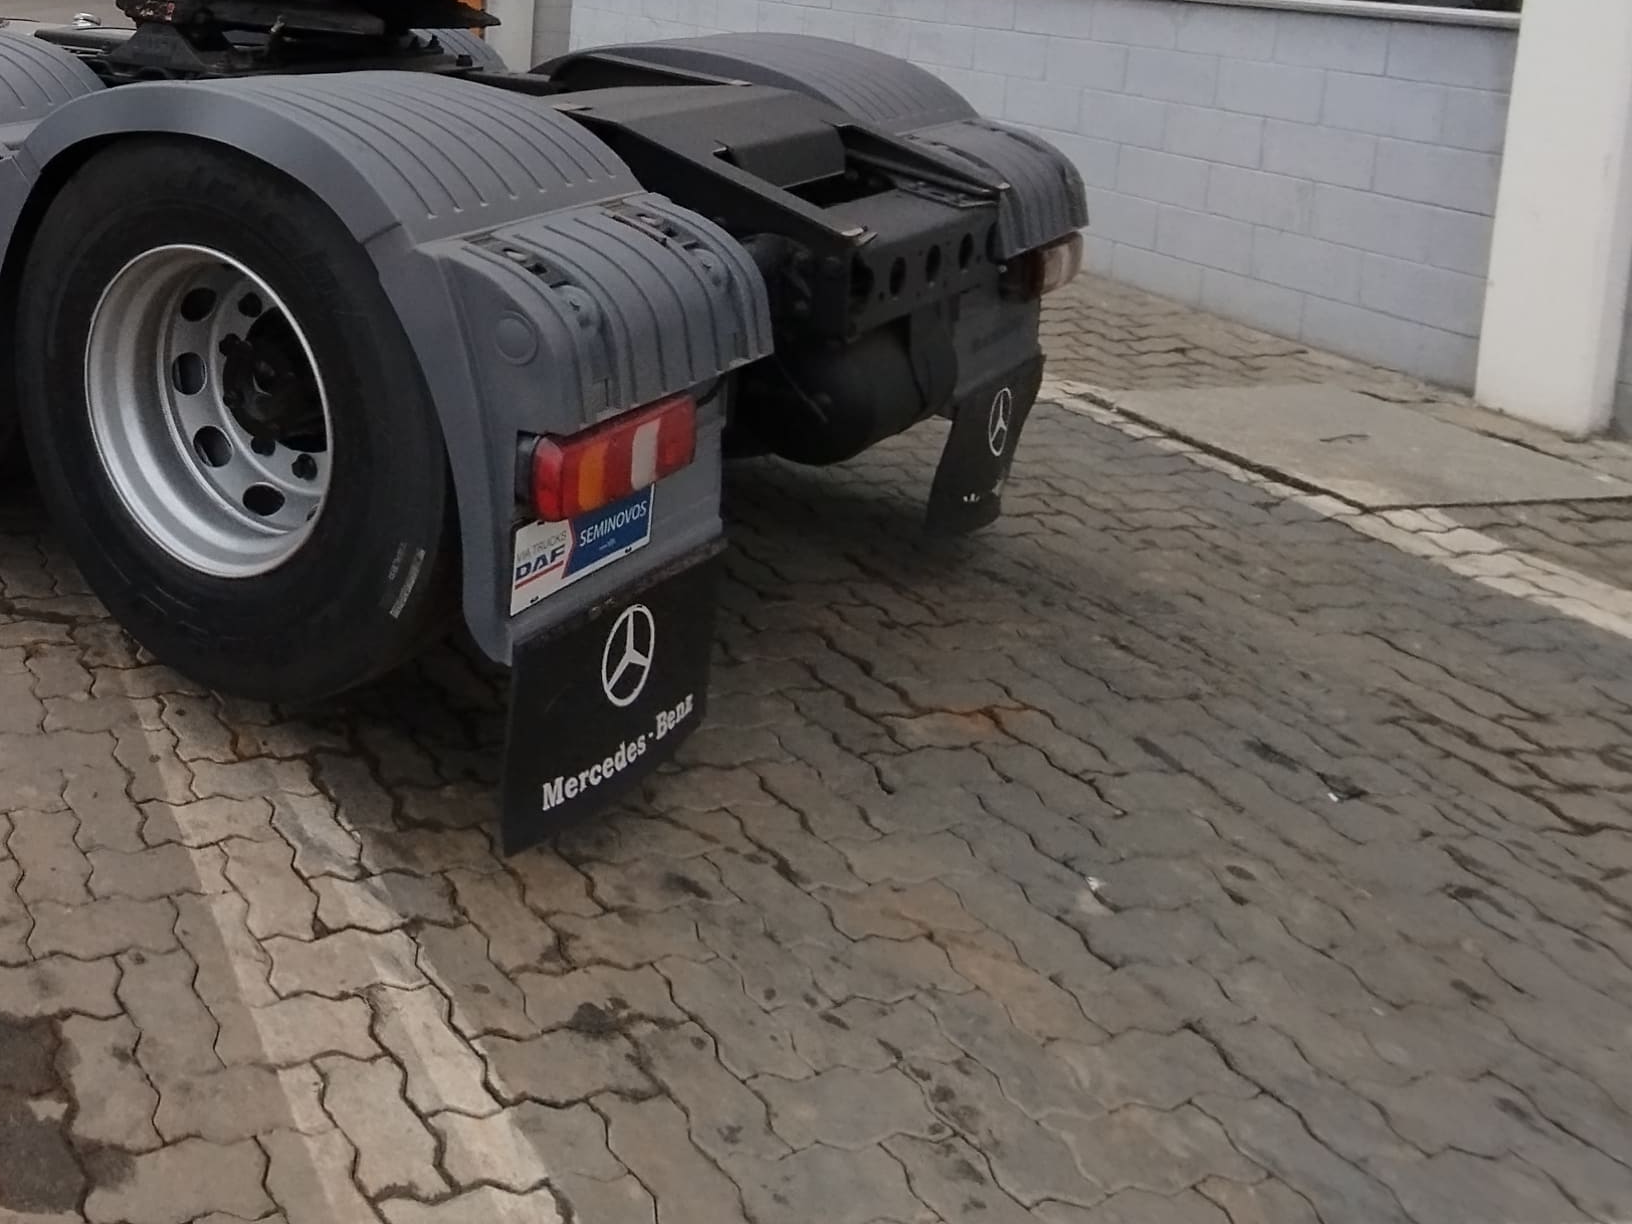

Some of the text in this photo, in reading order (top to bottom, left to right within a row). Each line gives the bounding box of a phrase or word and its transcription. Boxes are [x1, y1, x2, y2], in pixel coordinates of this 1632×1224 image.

[532, 530, 567, 552] TRUCKS
[579, 501, 647, 547] SEMINOVOS
[516, 544, 565, 581] DAF
